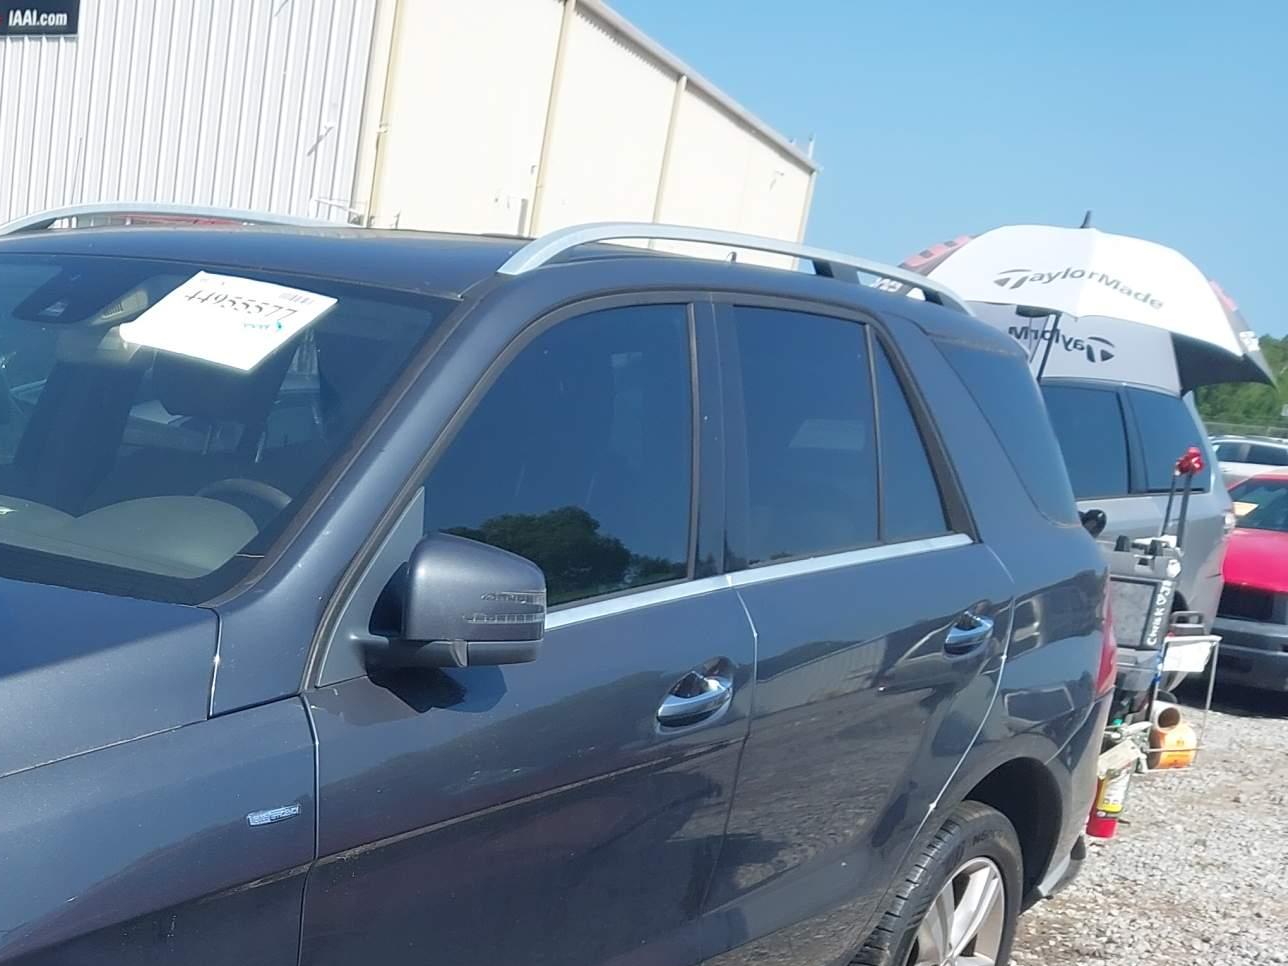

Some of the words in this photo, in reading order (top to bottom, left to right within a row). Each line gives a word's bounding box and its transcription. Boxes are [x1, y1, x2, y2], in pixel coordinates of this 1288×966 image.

[8, 9, 68, 26] IAAI.com
[993, 267, 1164, 310] TaylorMade
[185, 290, 298, 319] 44955577
